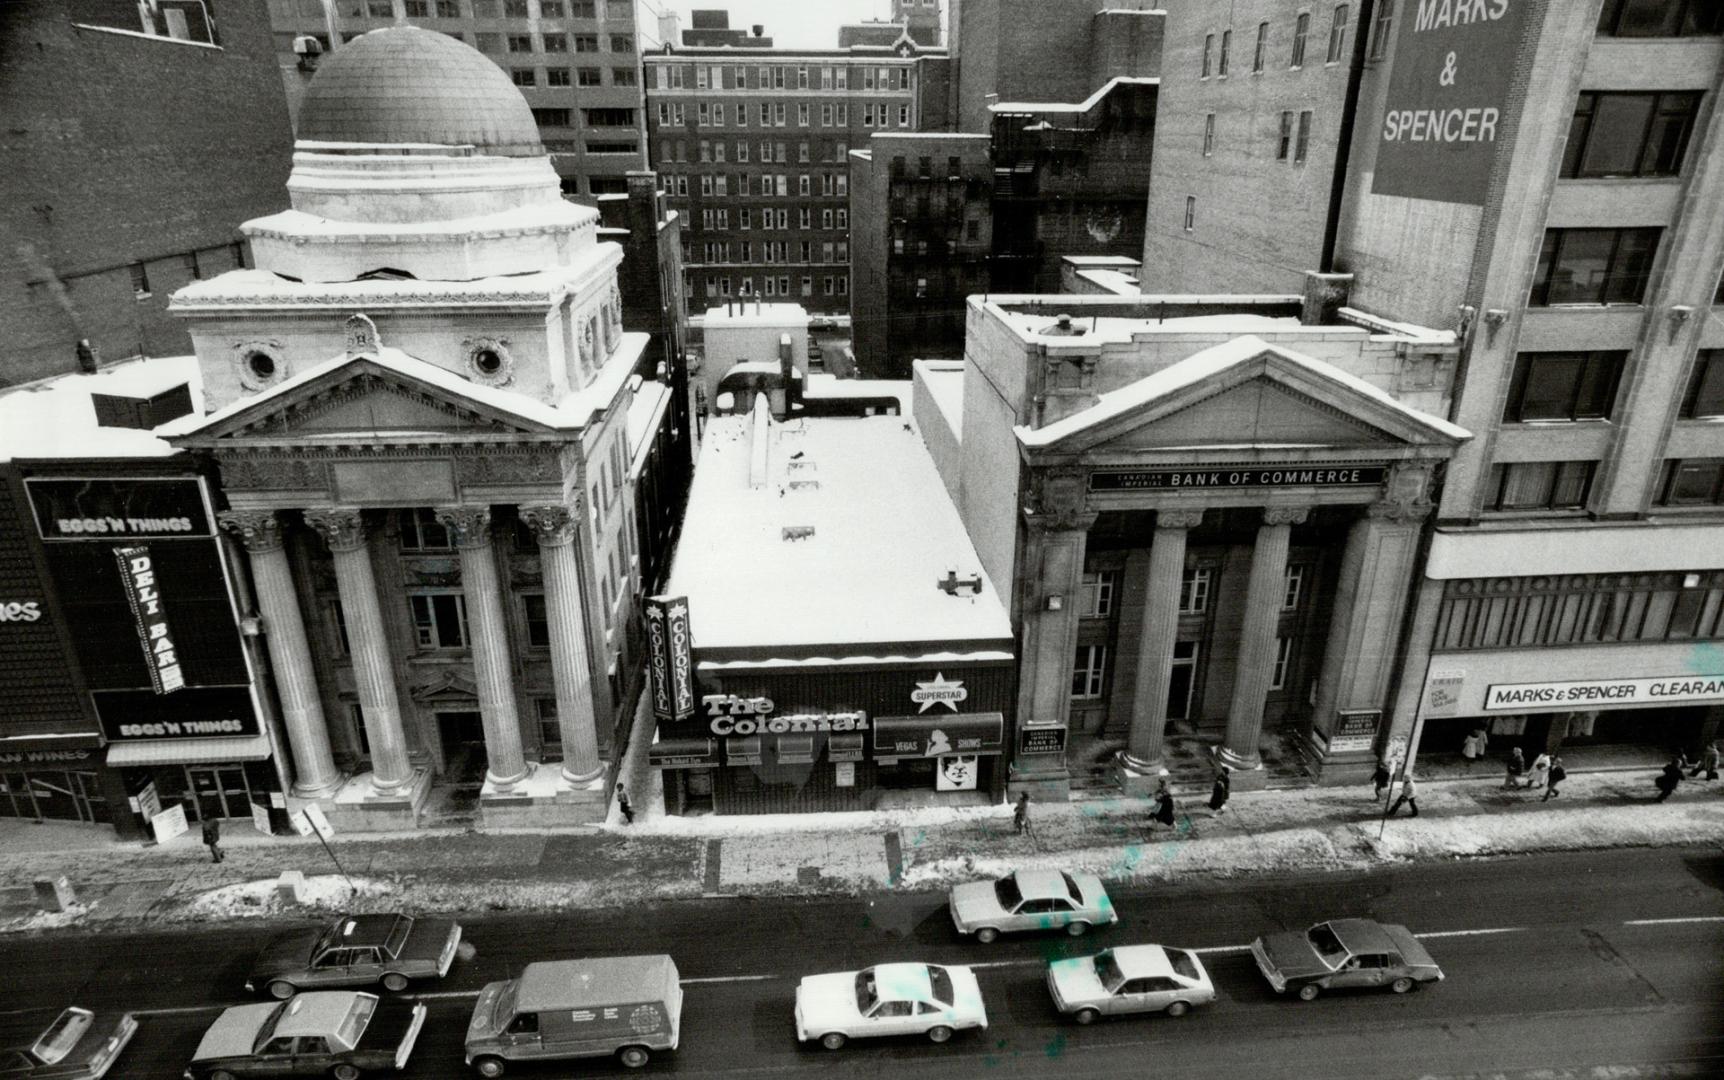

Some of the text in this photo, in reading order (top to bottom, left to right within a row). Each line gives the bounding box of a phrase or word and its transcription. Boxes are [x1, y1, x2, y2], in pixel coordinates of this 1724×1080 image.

[1414, 0, 1509, 32] MARKS
[1439, 51, 1458, 86] &
[1383, 107, 1500, 142] SPENCER
[1171, 470, 1361, 486] BANK OF COMMERCE
[127, 517, 192, 532] THINGS
[130, 556, 159, 615] DELI
[149, 622, 177, 667] BAR
[651, 622, 668, 710] COLONIAL
[672, 621, 691, 710] COLONIAL
[702, 694, 774, 716] The
[916, 690, 962, 701] SUPERSTAR
[1495, 688, 1554, 703] MARKS
[1555, 690, 1565, 700] &
[1567, 685, 1637, 700] SPENCER
[182, 719, 243, 734] THINGS
[710, 710, 869, 735] Colonial
[895, 741, 918, 751] VEGAS
